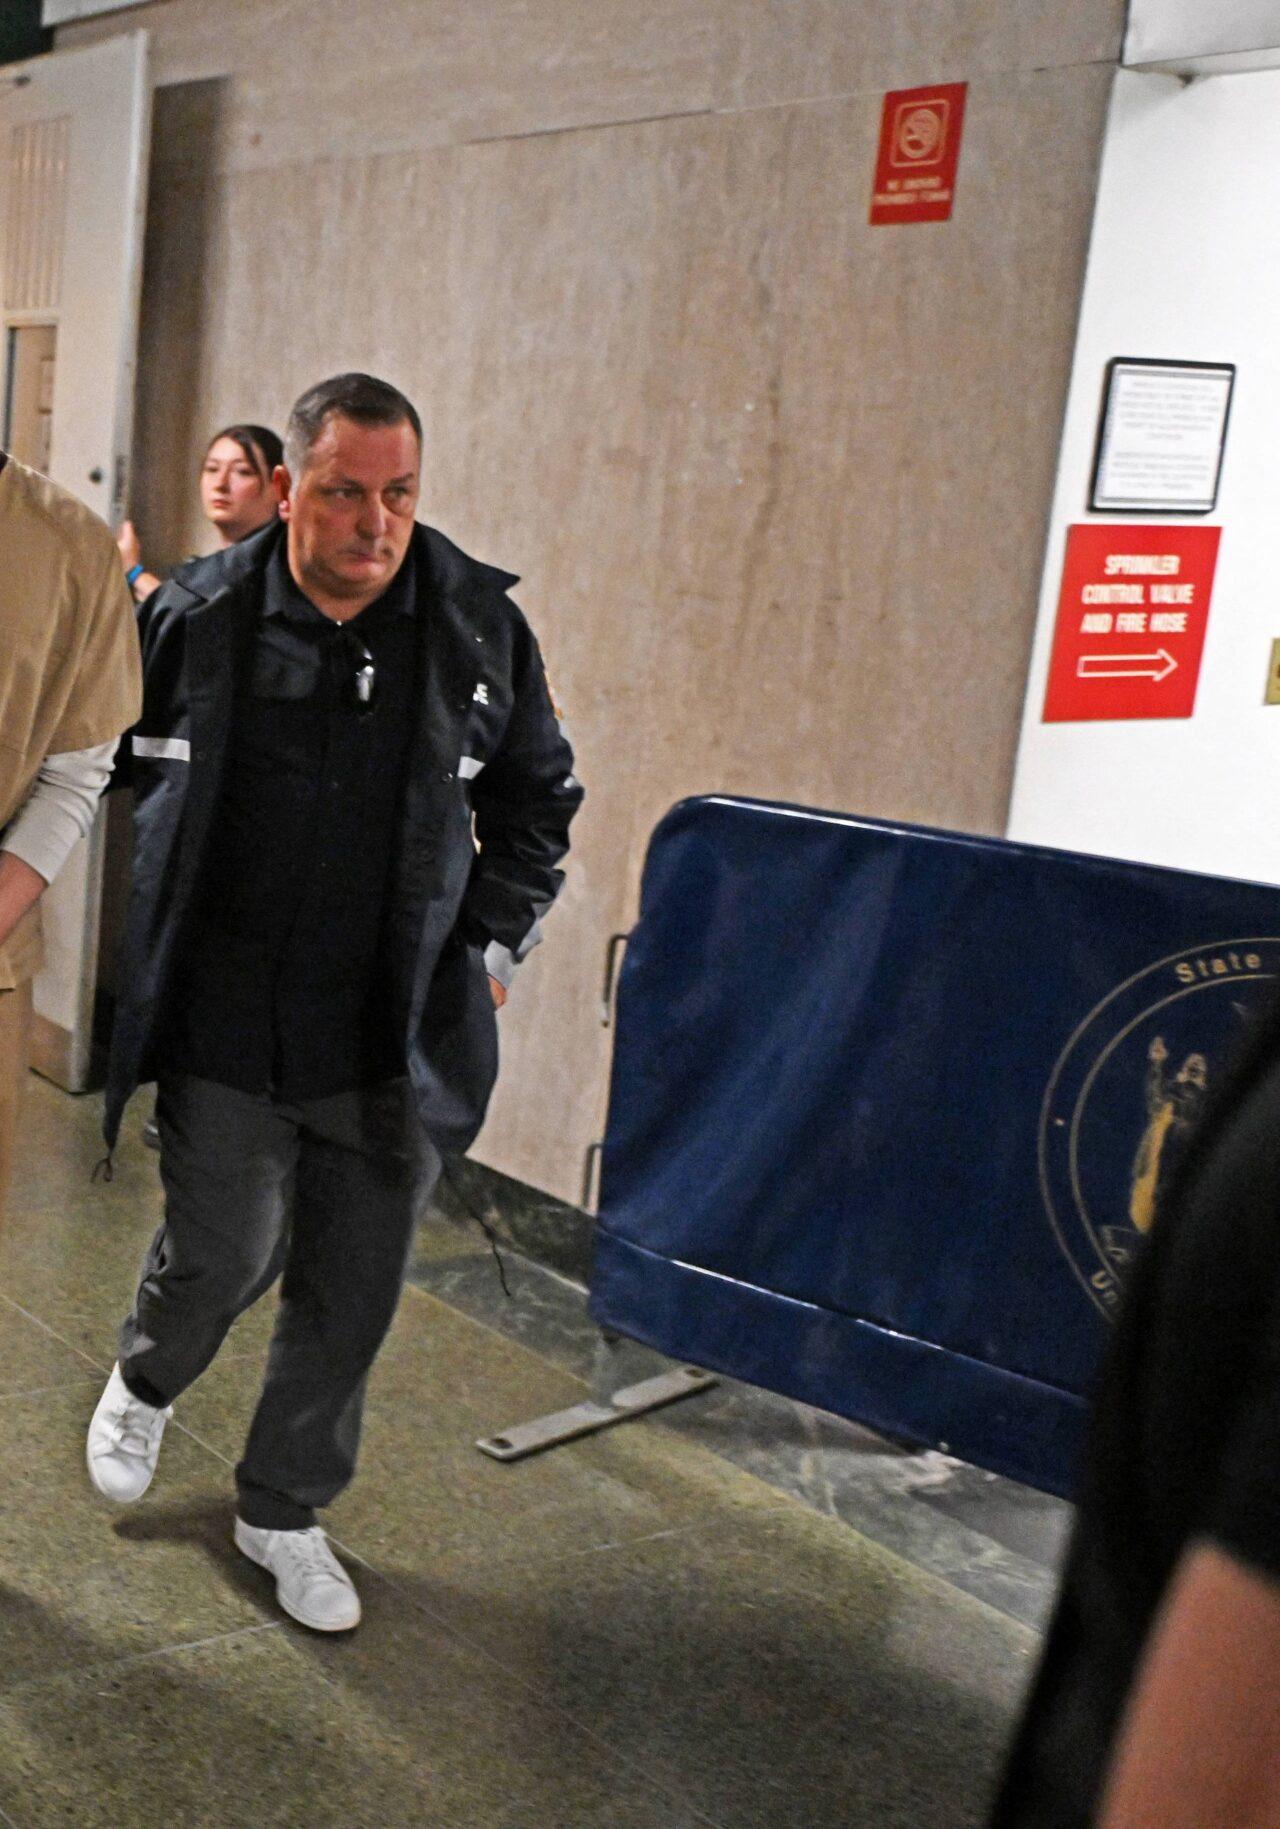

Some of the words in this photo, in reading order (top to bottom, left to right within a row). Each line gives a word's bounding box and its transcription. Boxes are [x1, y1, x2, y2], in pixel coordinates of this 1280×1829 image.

[1104, 554, 1181, 575] SPRINKLER
[1081, 584, 1144, 604] CONTROL
[1150, 584, 1195, 604] VALVE
[1080, 613, 1113, 633] AND
[1115, 613, 1148, 633] FIRE
[1149, 613, 1189, 633] HOSE
[1175, 952, 1261, 983] State
